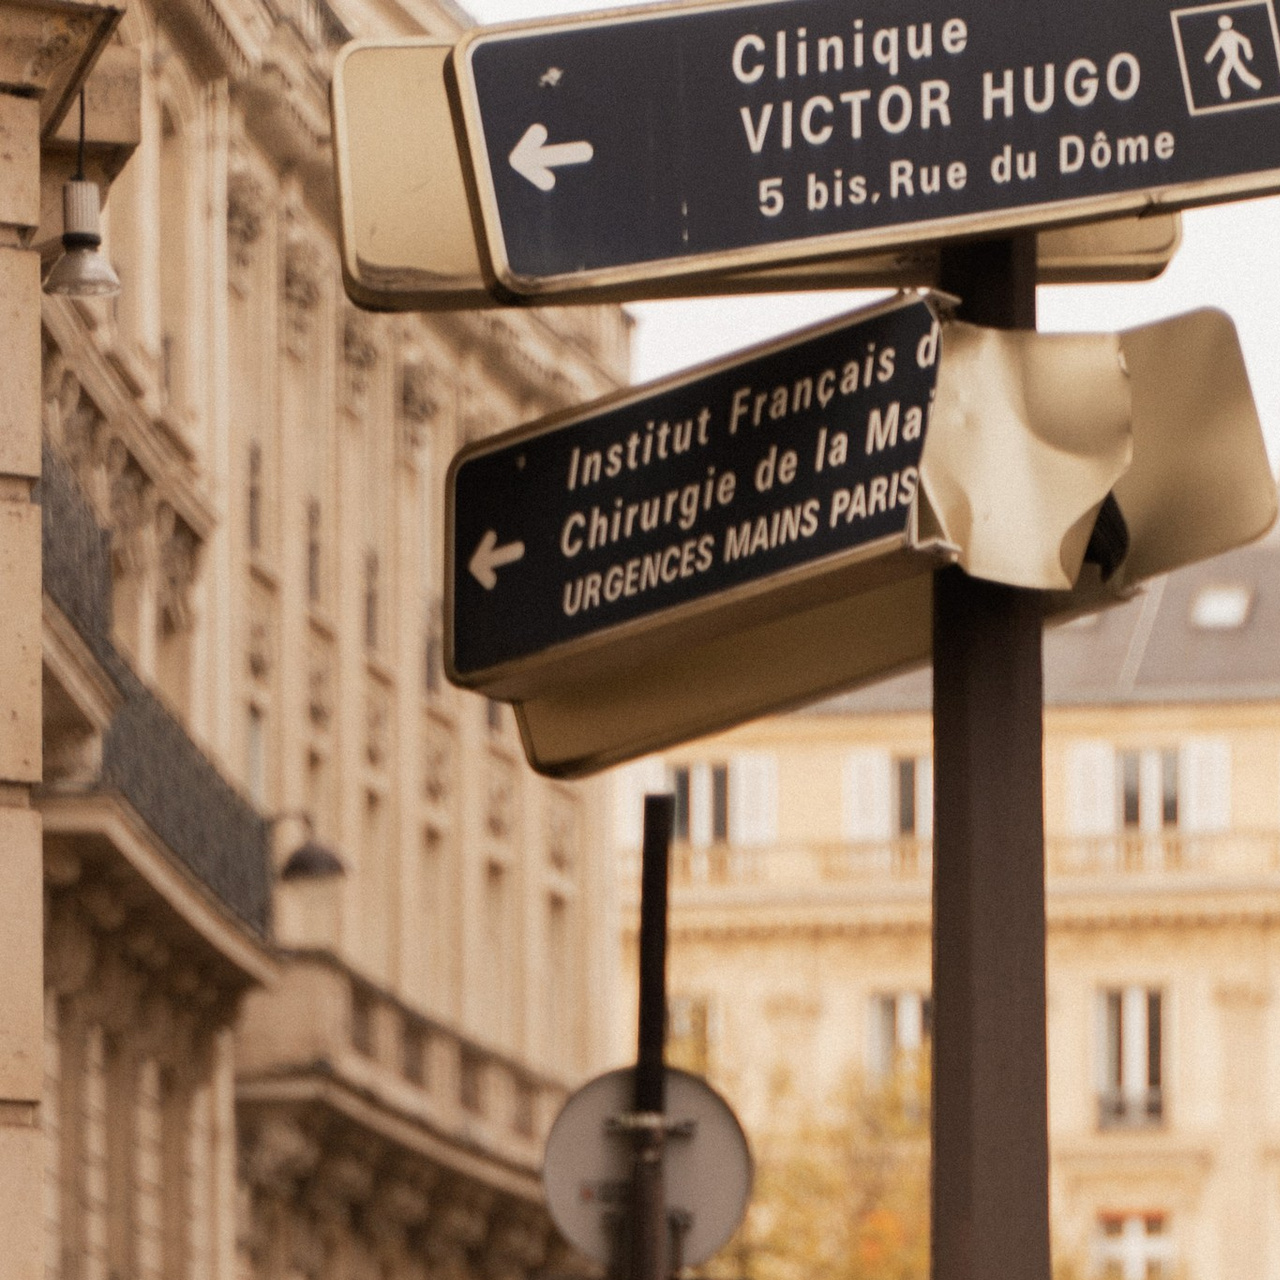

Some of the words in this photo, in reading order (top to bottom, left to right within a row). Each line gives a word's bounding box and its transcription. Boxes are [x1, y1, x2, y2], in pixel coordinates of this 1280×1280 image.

[731, 18, 969, 84] Clinique
[740, 79, 952, 154] VICTOR
[982, 52, 1142, 121] HUGO
[758, 177, 785, 217] 5
[990, 143, 1038, 184] du
[1059, 129, 1176, 174] Dôme
[568, 407, 711, 490] Institut
[729, 341, 897, 435] Français
[561, 467, 736, 559] Chirurgie
[754, 446, 799, 492] de
[814, 428, 849, 472] la
[563, 535, 715, 616] URGENCES
[723, 498, 821, 564] MAINS
[829, 466, 918, 528] PARIS
